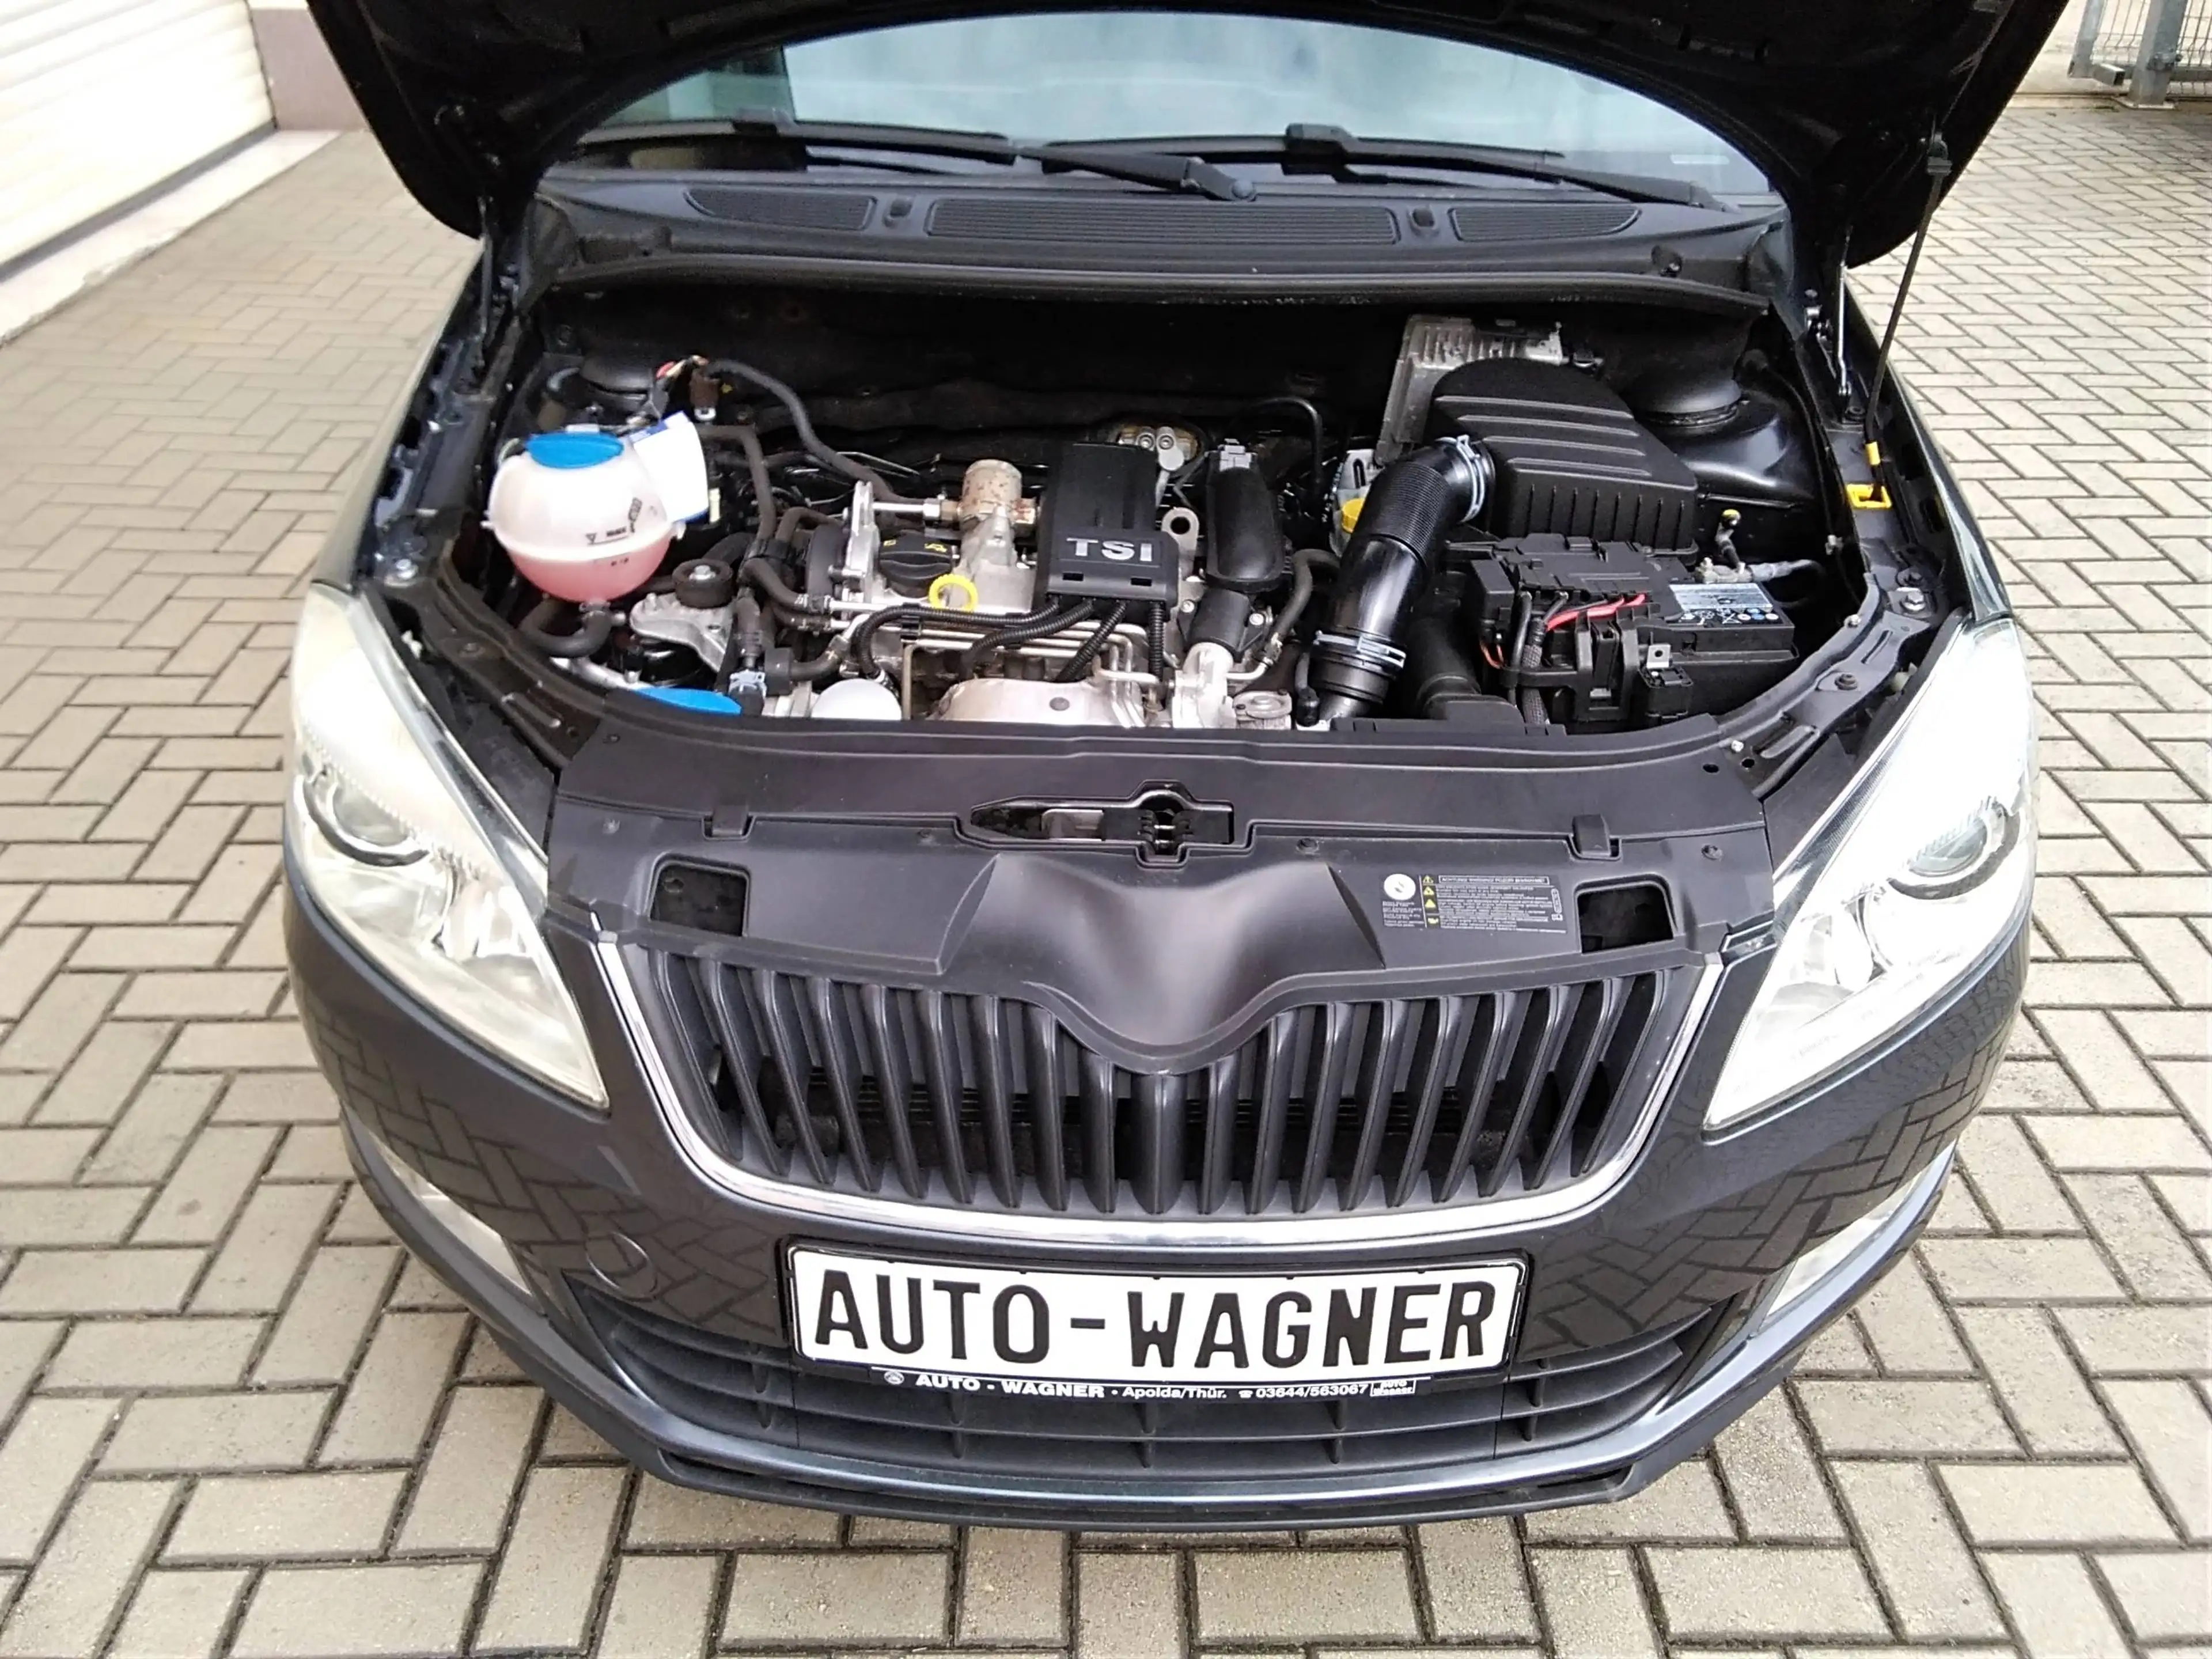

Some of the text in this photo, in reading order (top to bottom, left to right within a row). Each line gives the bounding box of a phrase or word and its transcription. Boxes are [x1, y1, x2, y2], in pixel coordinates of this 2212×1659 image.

[1066, 537, 1152, 562] TSI
[915, 1374, 980, 1391] AUTO
[1001, 1380, 1105, 1398] WAGNER
[1255, 1384, 1369, 1398] 03644/563067
